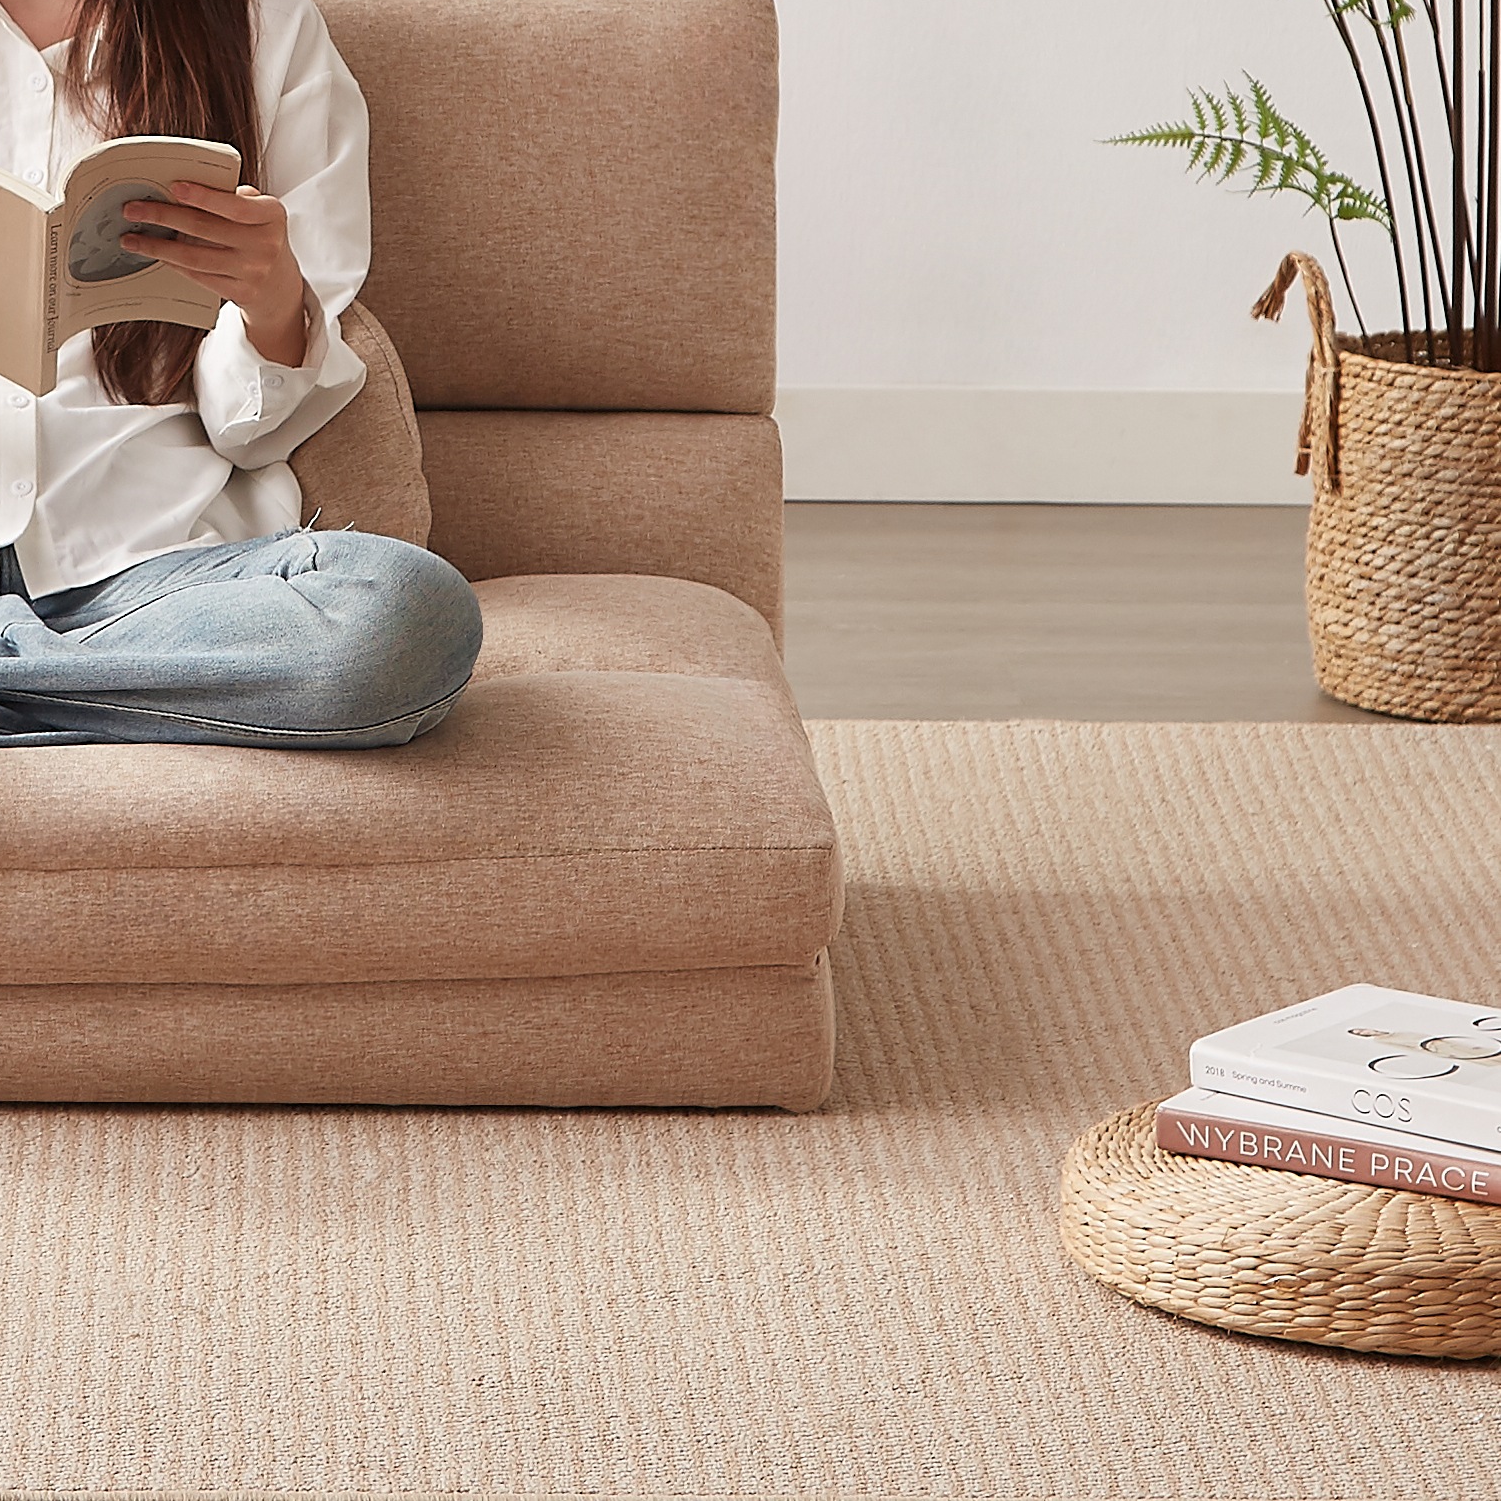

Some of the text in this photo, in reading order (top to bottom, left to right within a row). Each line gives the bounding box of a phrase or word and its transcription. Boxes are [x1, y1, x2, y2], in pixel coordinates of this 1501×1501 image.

[50, 223, 62, 254] Learn
[49, 255, 58, 282] more
[48, 283, 57, 297] on
[48, 298, 57, 315] our
[1205, 1065, 1225, 1077] 2018
[1232, 1070, 1258, 1085] Spring
[1259, 1077, 1275, 1087] and
[1351, 1089, 1412, 1123] COS
[1175, 1120, 1490, 1196] WYBRANE PRACE
